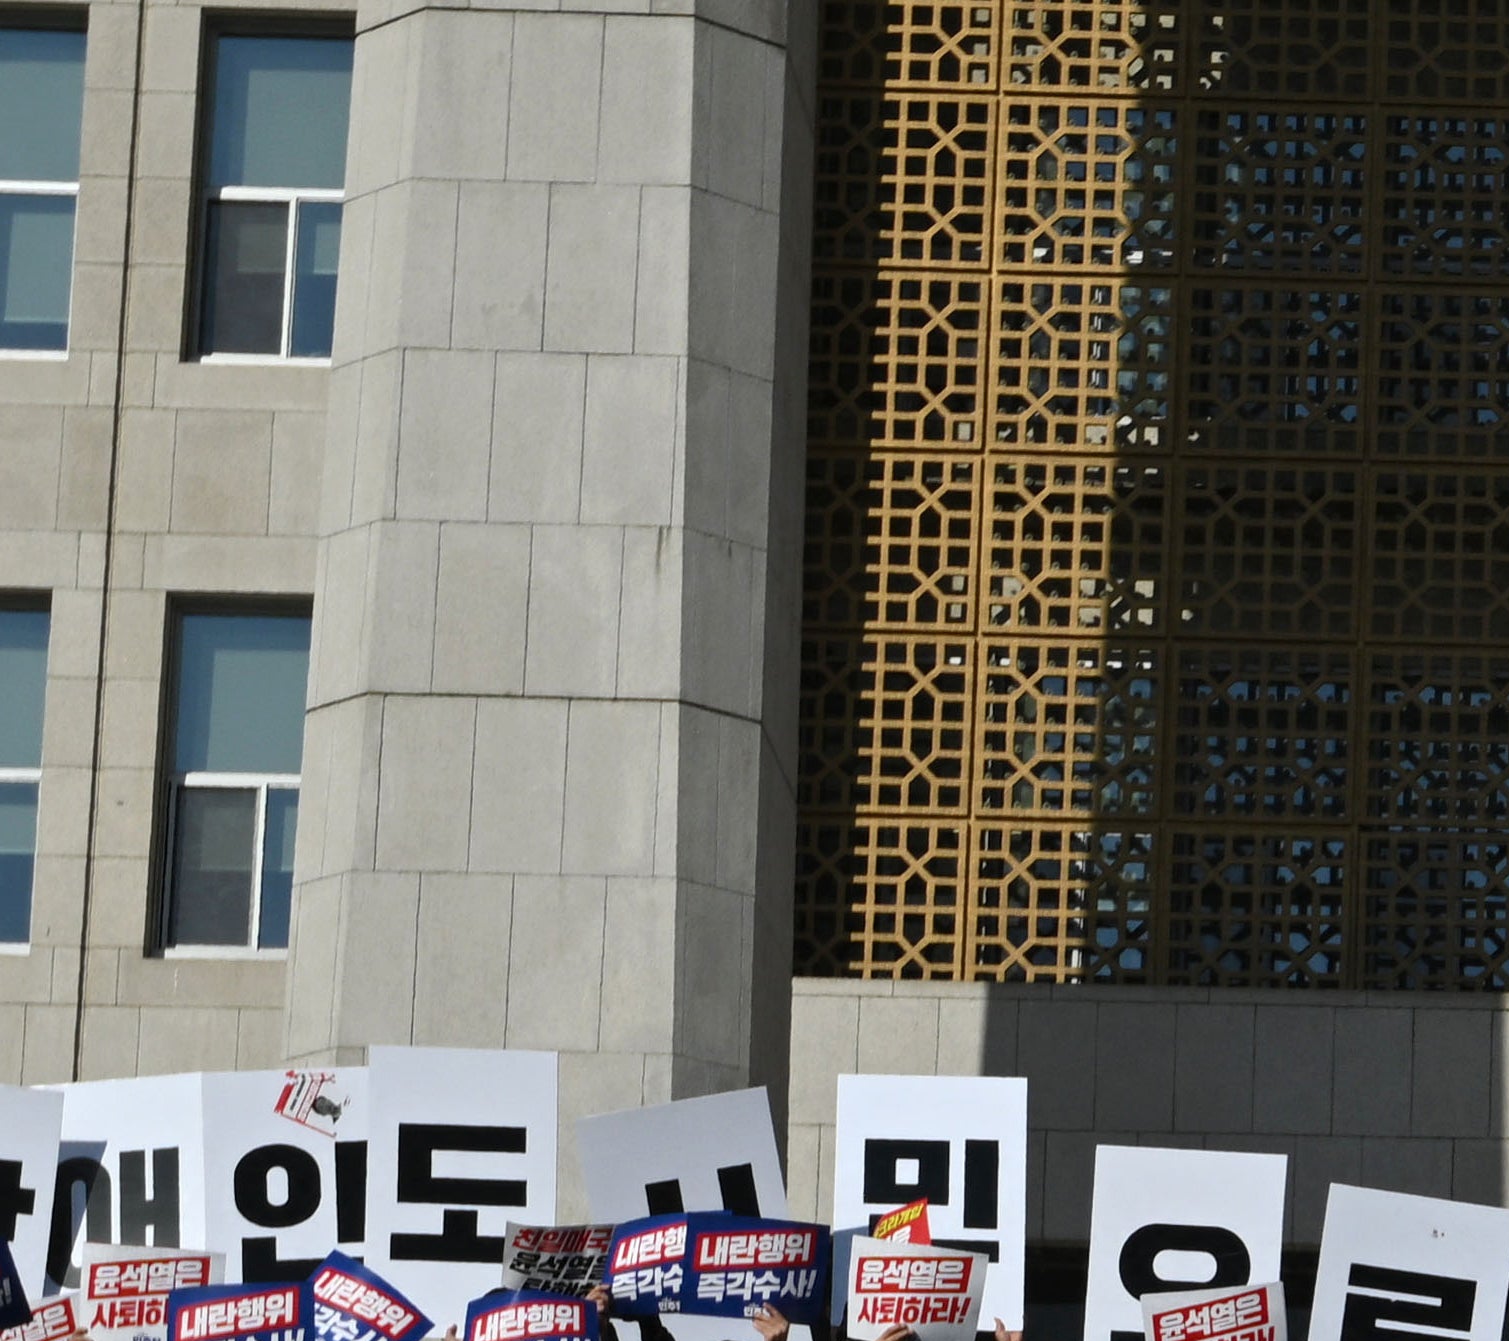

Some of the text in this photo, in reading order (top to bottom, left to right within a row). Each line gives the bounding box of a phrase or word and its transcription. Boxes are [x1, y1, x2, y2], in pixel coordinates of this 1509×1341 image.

[860, 1259, 964, 1290] 윤석열은
[180, 1291, 294, 1340] 내란행위
[858, 1296, 972, 1325] 사퇴하라!
